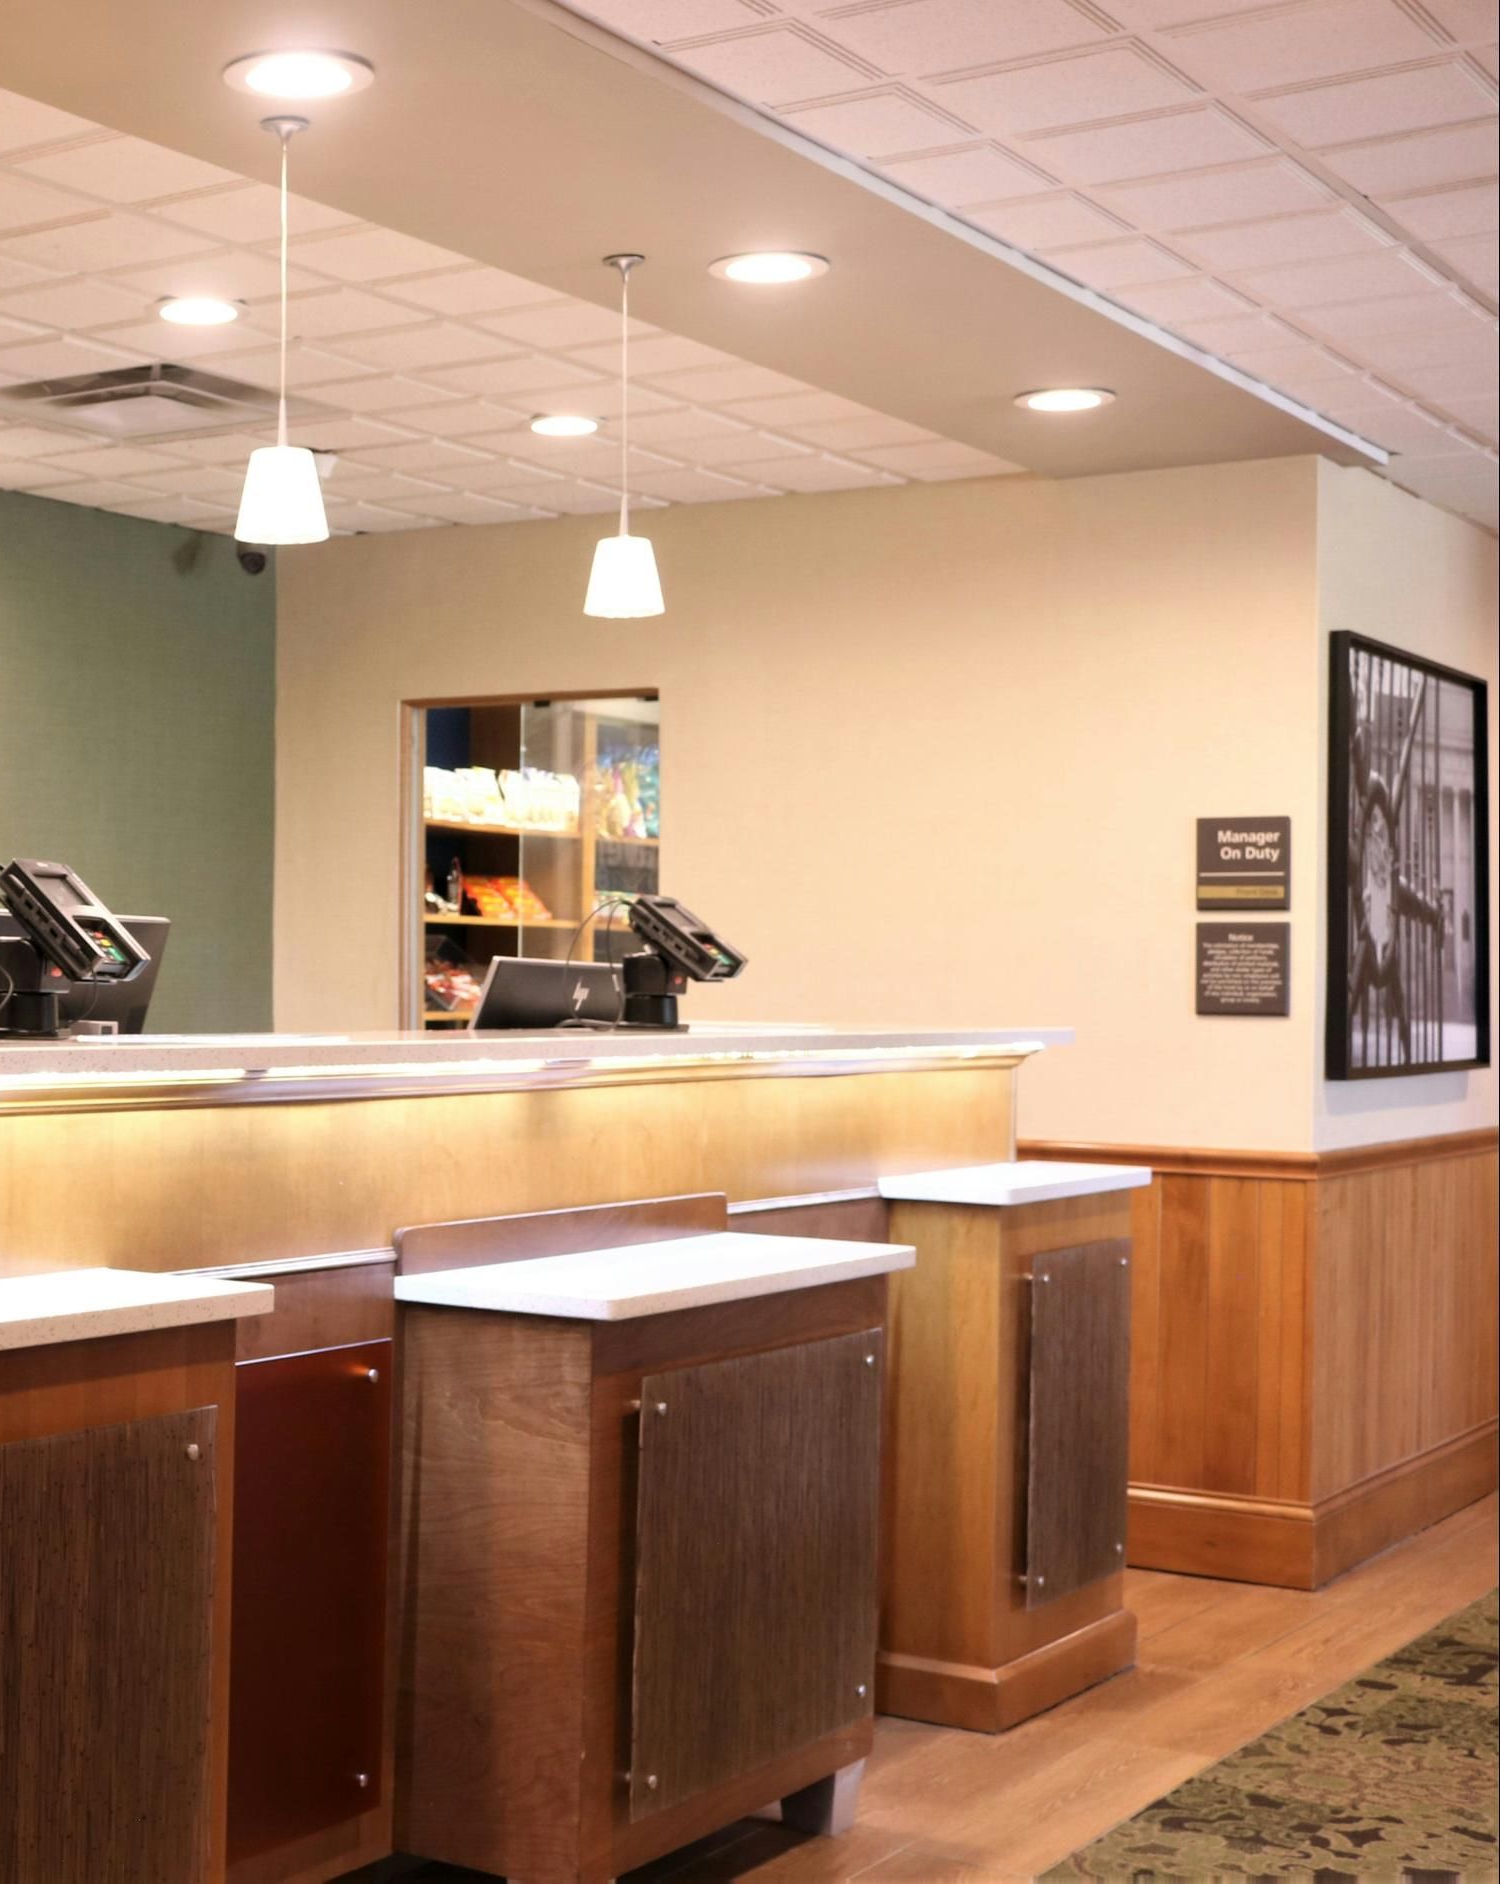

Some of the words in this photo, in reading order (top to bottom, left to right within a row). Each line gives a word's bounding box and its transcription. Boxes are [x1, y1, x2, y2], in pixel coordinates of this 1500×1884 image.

[1217, 830, 1280, 845] Manager
[1220, 847, 1241, 860] On
[1245, 846, 1280, 862] Duty
